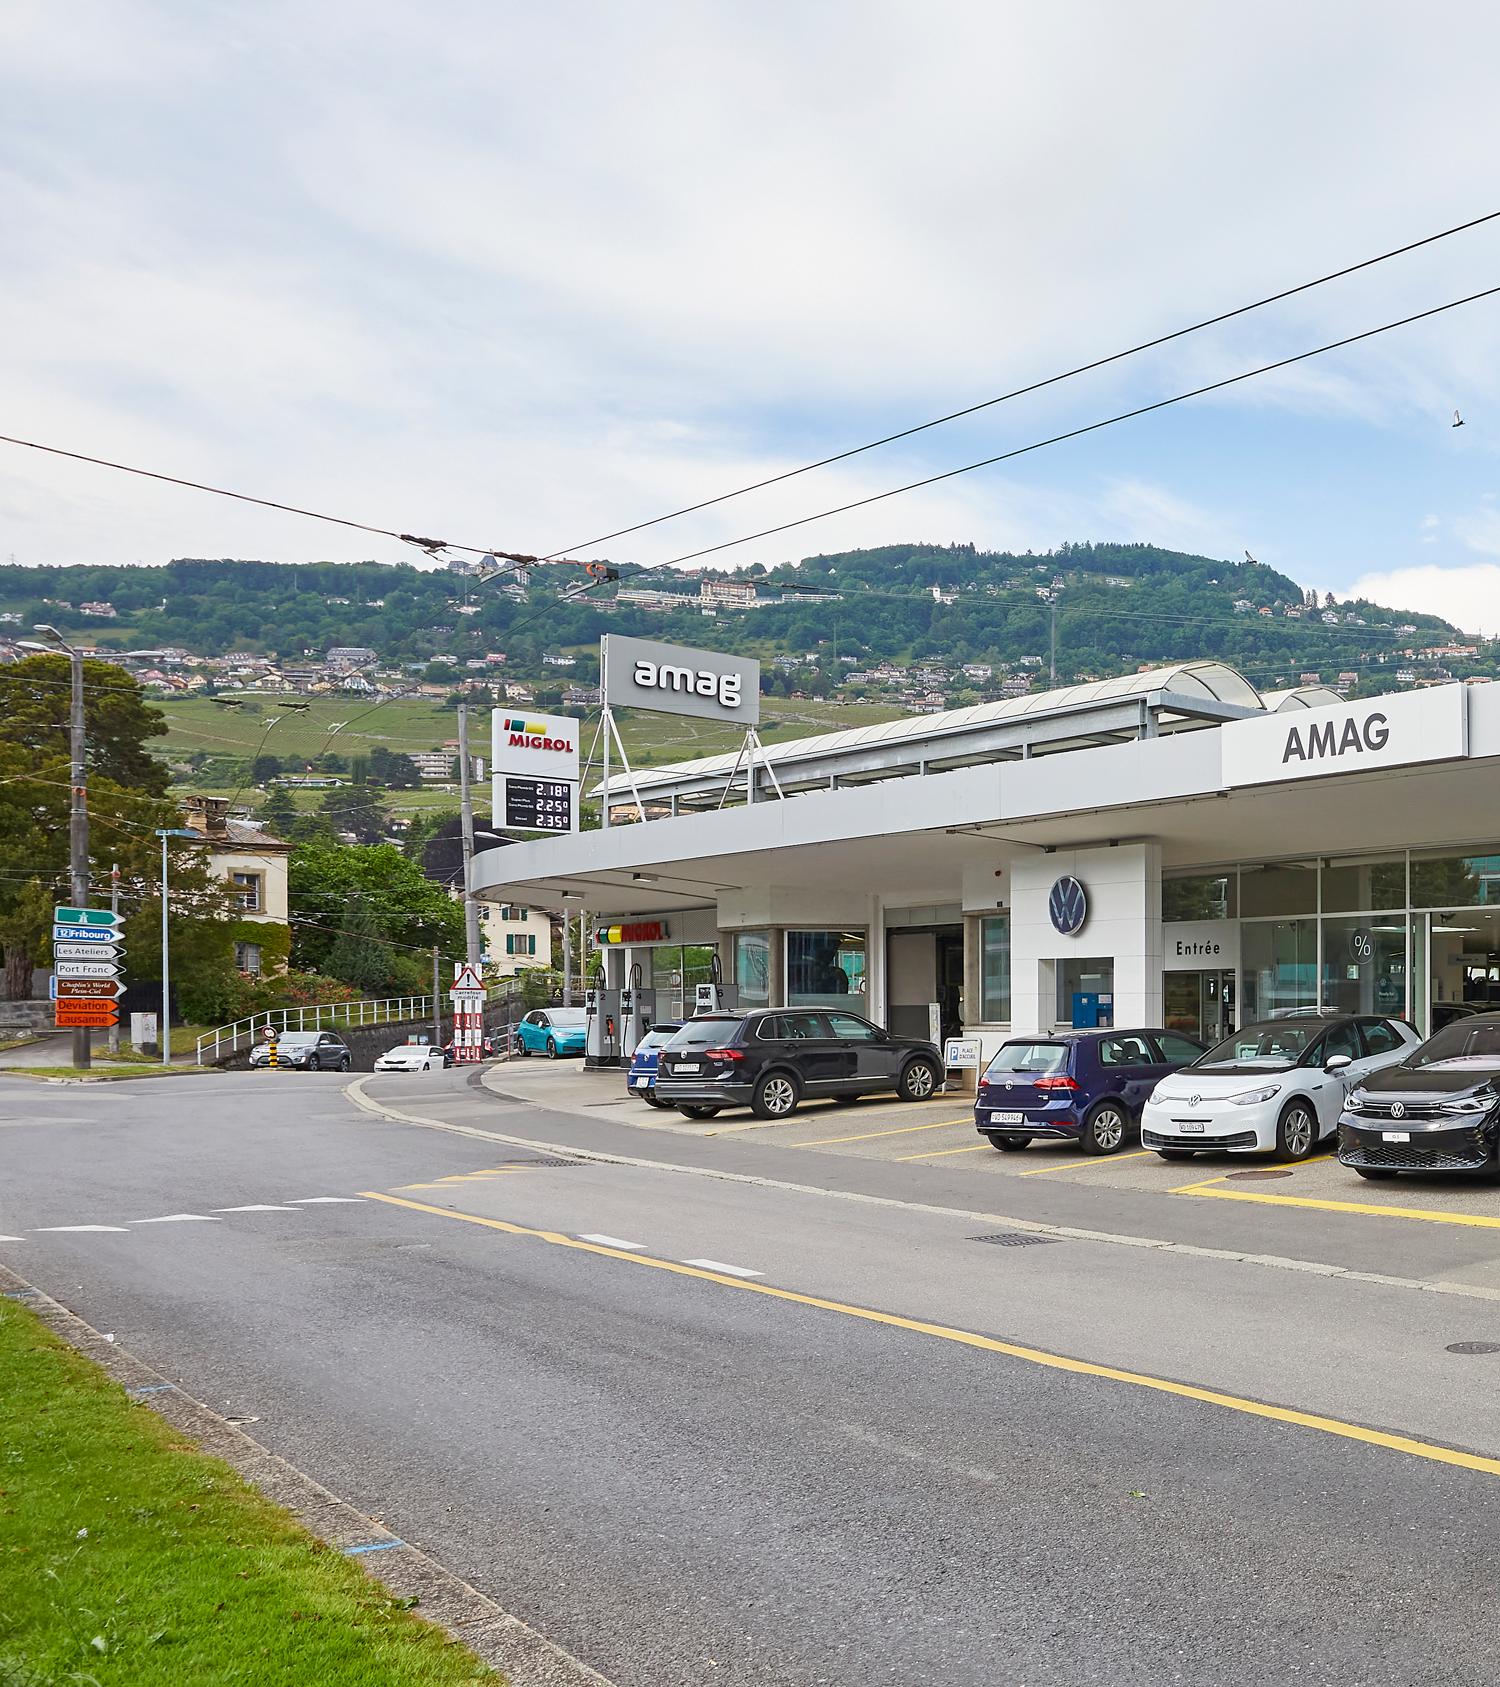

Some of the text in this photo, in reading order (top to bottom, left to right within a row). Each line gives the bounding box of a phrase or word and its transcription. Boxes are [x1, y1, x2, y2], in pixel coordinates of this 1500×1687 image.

[634, 660, 741, 707] amag
[1282, 712, 1389, 763] AMAG
[508, 734, 573, 753] MIGROL
[71, 929, 111, 940] Fribourg
[58, 946, 109, 955] Les Ateliers
[1176, 940, 1220, 956] Entrée
[60, 965, 109, 973] Port Franc
[58, 1001, 108, 1010] Déviation
[58, 1014, 108, 1024] Lausanne
